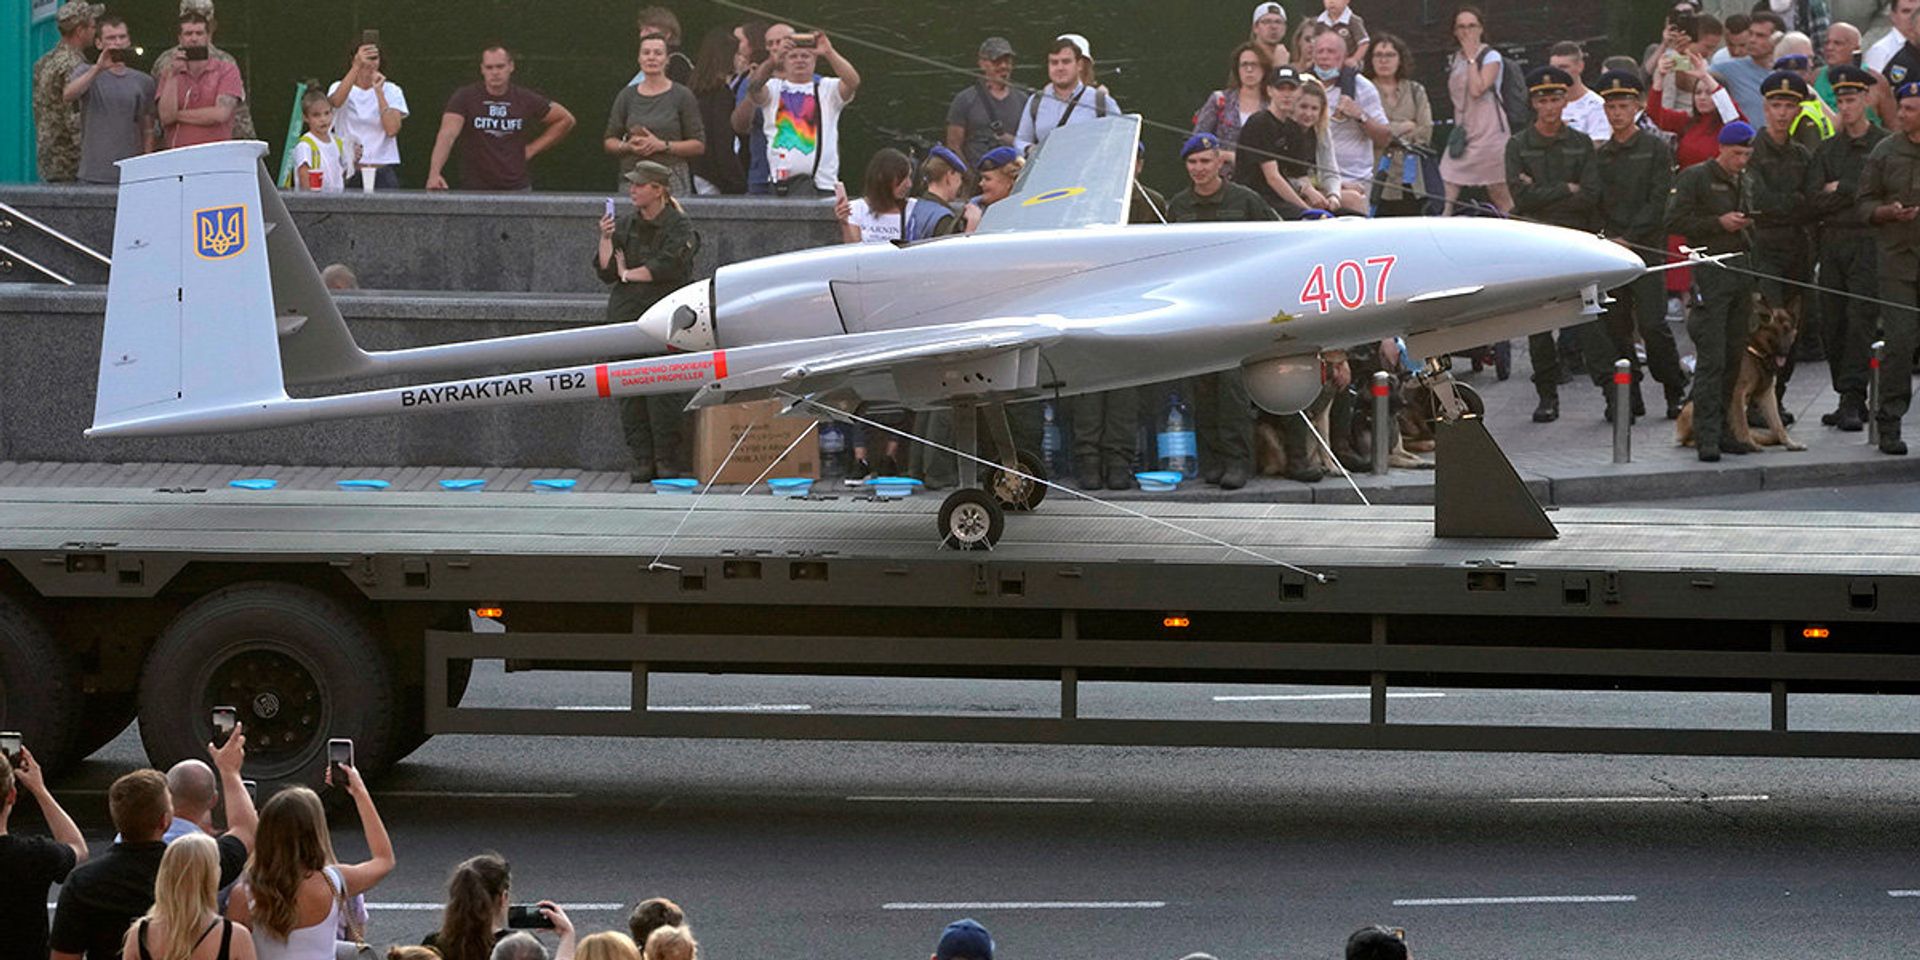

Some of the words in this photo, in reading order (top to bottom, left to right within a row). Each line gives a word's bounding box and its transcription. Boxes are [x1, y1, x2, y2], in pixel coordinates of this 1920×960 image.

[489, 105, 507, 117] BIG
[474, 117, 498, 129] CITY
[501, 118, 523, 130] LIFE
[1300, 255, 1397, 313] 407
[621, 374, 656, 387] DANGER
[657, 371, 704, 383] PROPELLER
[401, 377, 534, 407] BAYRAKTAR
[545, 372, 587, 392] TB2
